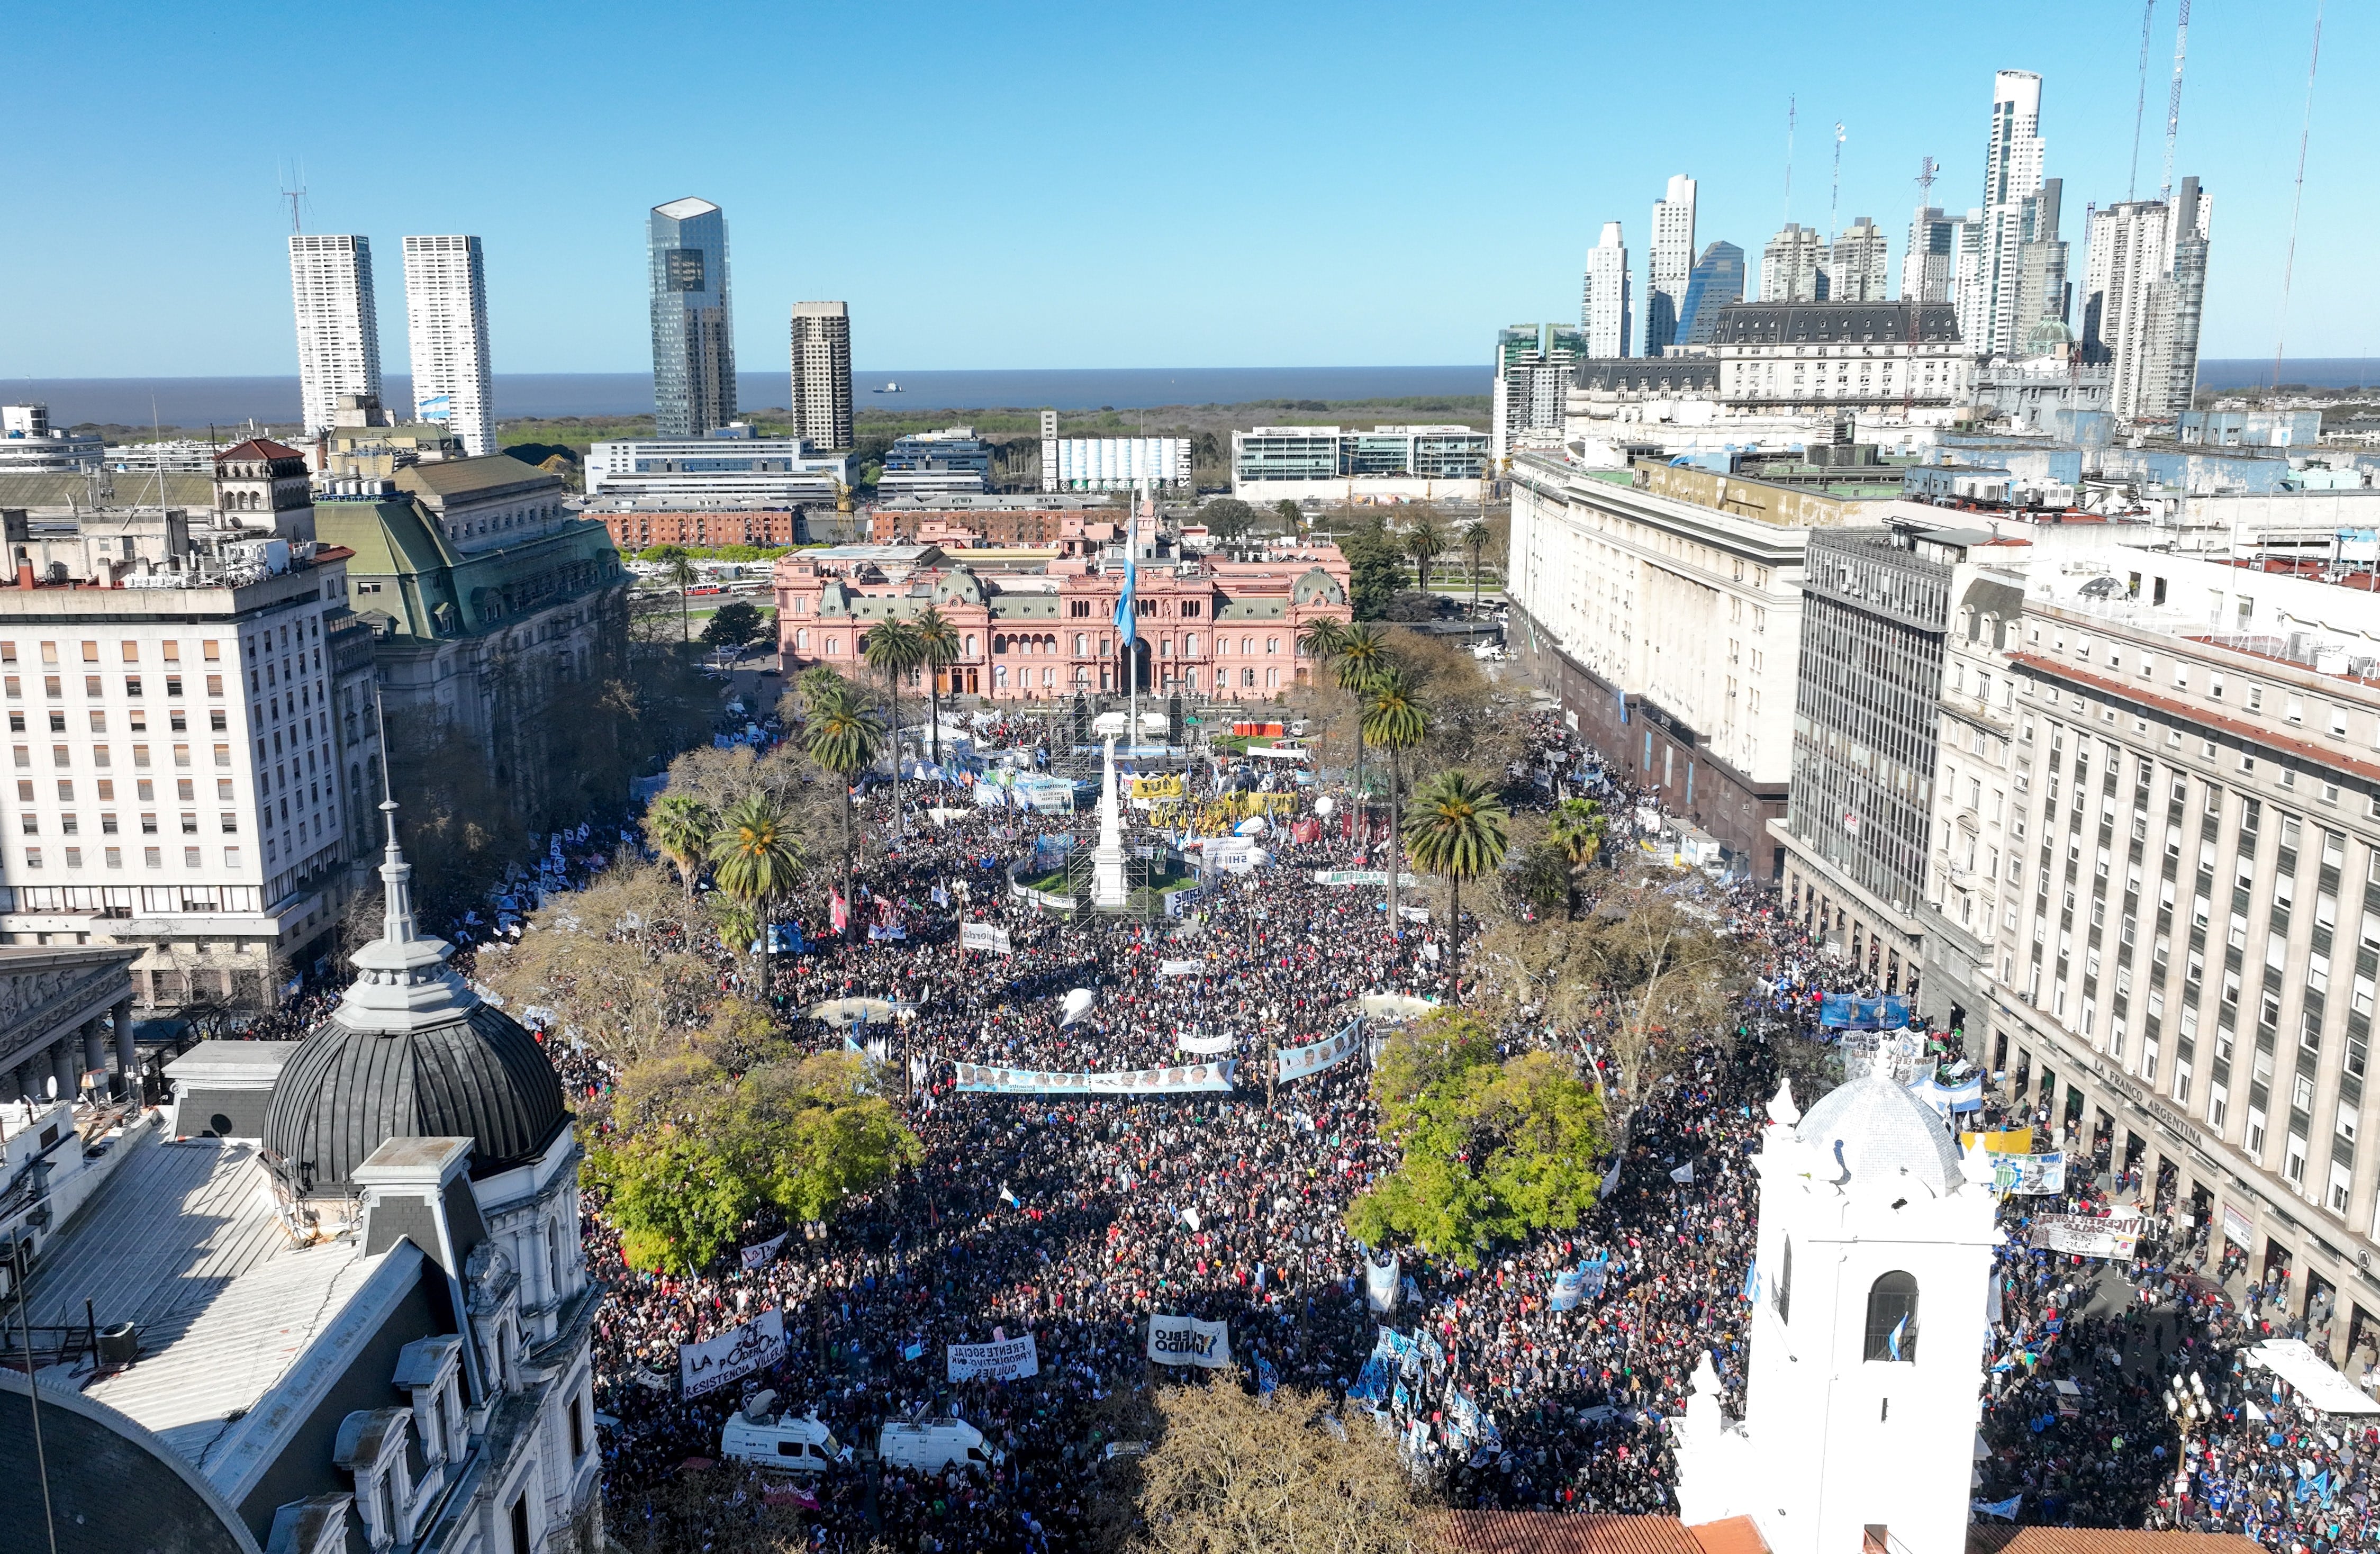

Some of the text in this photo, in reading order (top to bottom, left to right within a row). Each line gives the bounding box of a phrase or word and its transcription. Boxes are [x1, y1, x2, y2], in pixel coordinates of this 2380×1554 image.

[1178, 438, 1191, 487] MUJERES
[2095, 1060, 2202, 1146] LA FRANCO ARGENTINA
[685, 1364, 750, 1397] RESISTENCIA
[754, 1343, 784, 1369] VILLERA
[691, 1354, 713, 1373] LA
